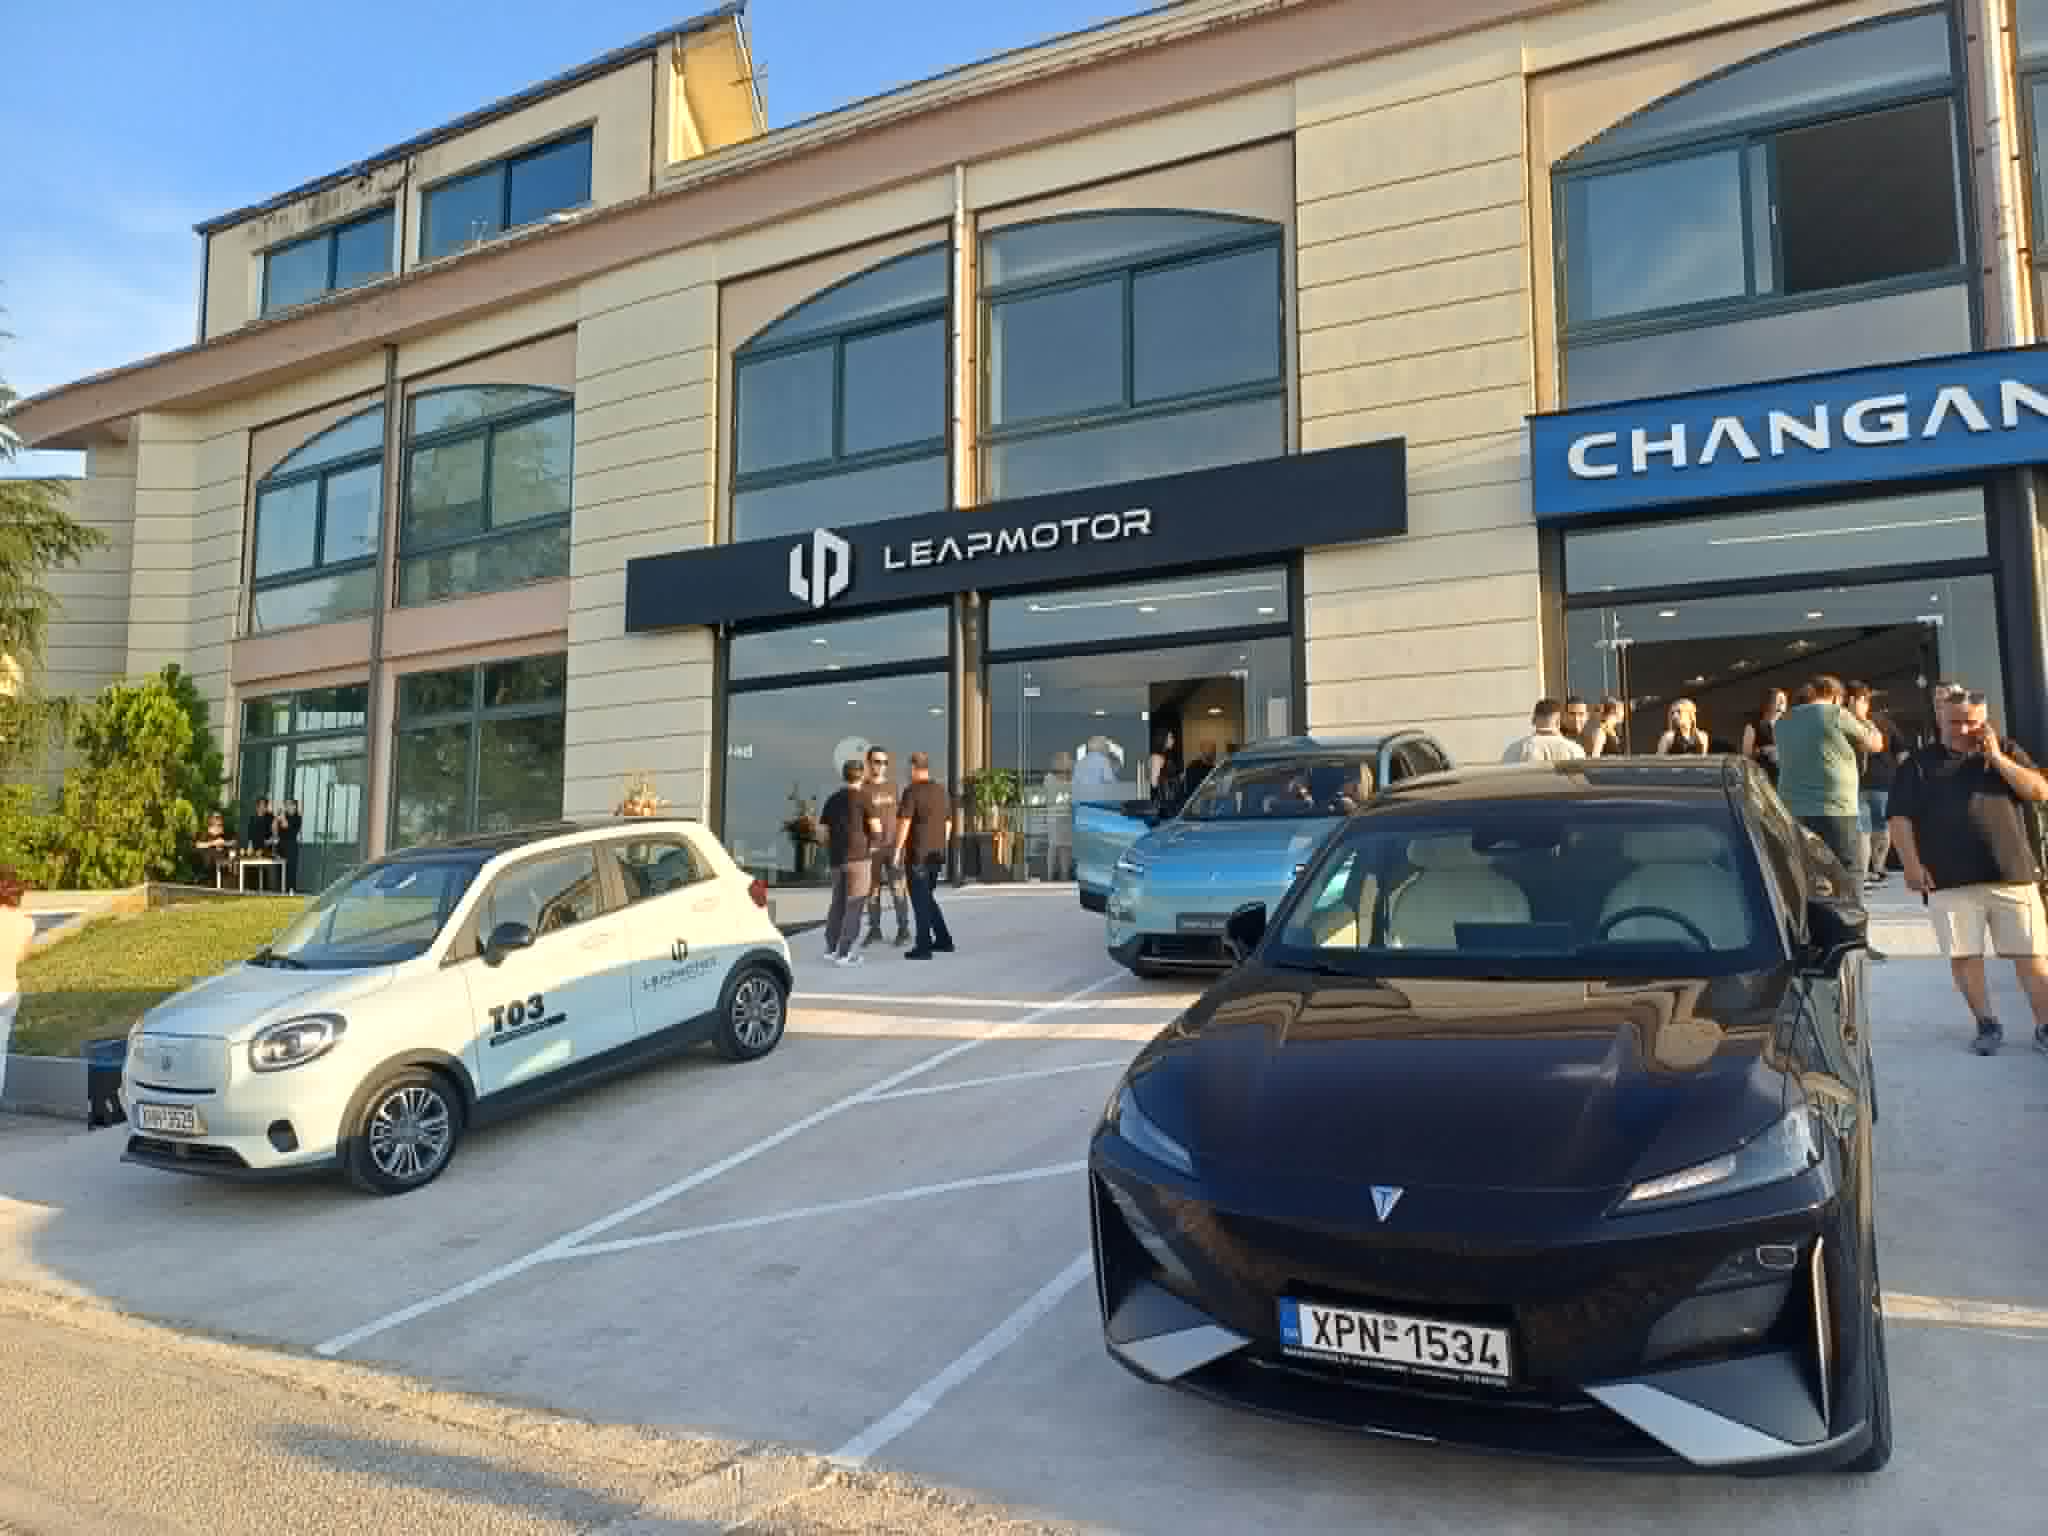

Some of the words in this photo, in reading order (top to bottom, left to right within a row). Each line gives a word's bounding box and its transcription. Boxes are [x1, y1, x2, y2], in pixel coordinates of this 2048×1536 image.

[1567, 379, 2048, 479] CHANGAN
[884, 508, 1152, 570] LEAPMOTOR
[1311, 1309, 1501, 1370] XPN-1534
